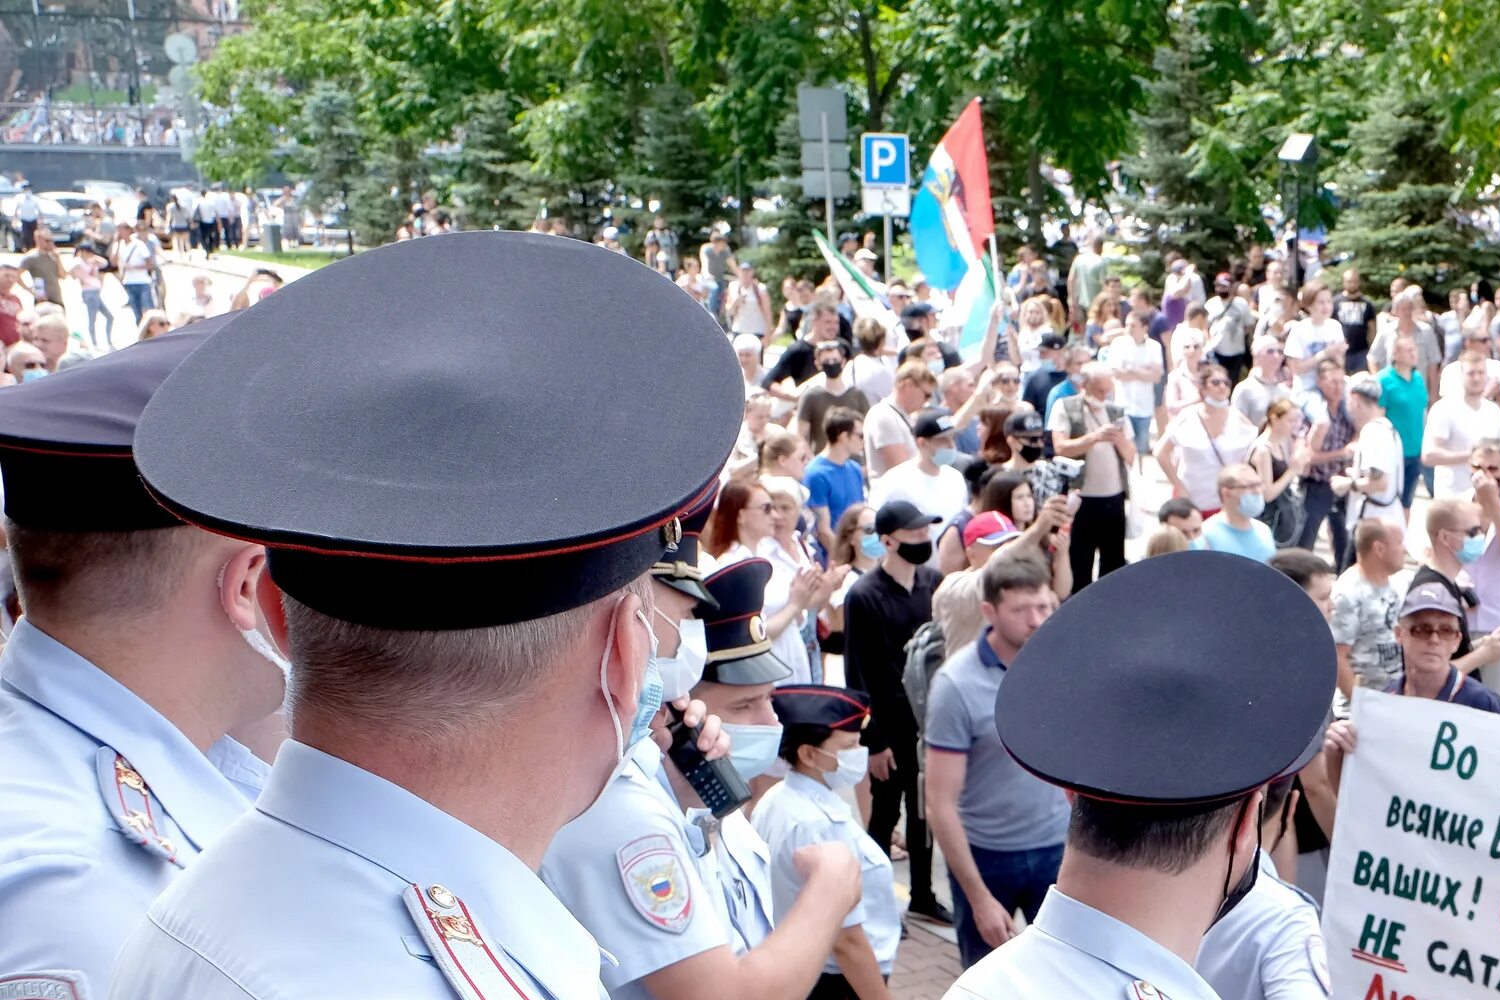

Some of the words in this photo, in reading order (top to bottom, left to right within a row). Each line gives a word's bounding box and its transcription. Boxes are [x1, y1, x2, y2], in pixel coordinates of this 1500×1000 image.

[871, 139, 897, 180] P
[1430, 721, 1478, 781] Во
[1385, 795, 1484, 850] всякие
[1357, 913, 1406, 962] НЕ
